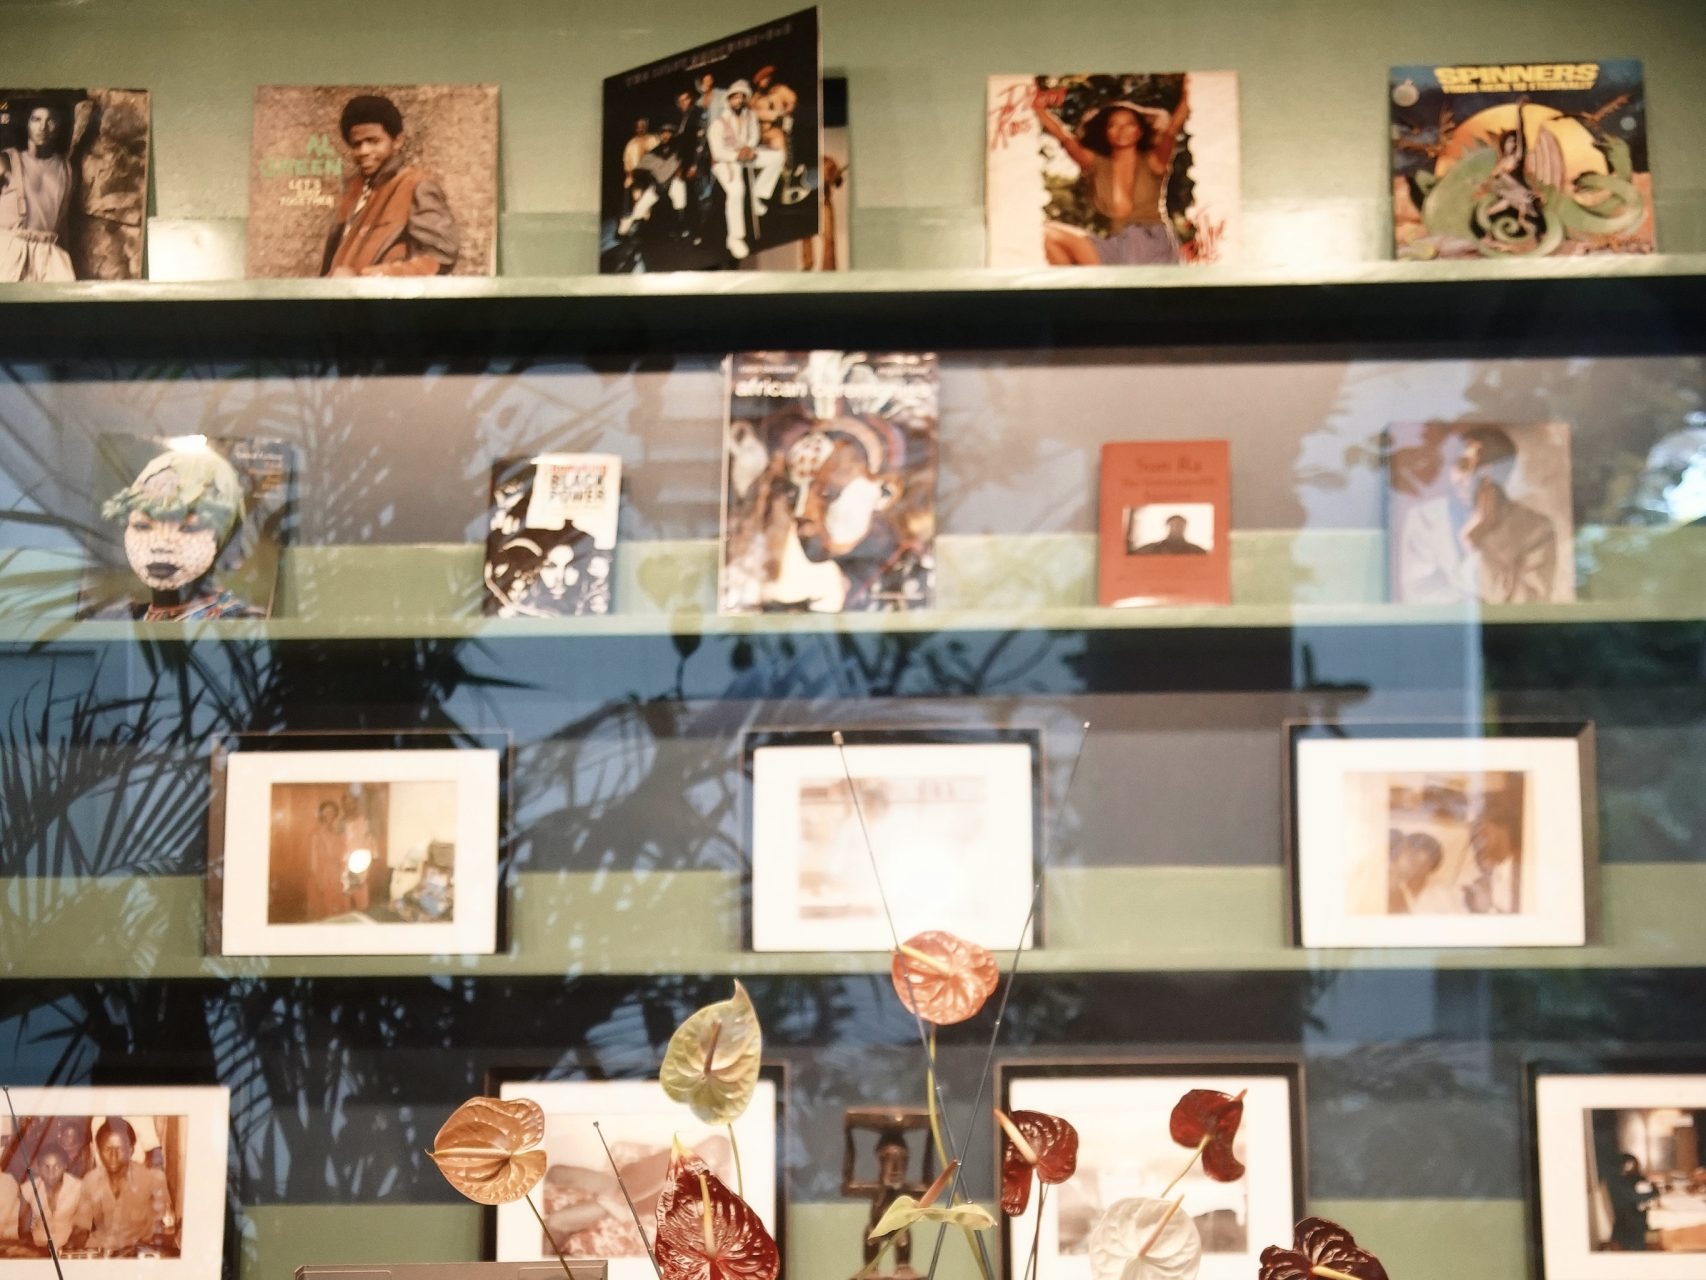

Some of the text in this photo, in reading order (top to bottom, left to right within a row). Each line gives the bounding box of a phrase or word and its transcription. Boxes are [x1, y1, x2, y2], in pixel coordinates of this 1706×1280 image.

[1434, 64, 1599, 85] SPINNERS
[305, 133, 336, 157] AL
[259, 157, 342, 179] GREEN
[734, 377, 808, 398] african
[551, 474, 605, 488] BLACK
